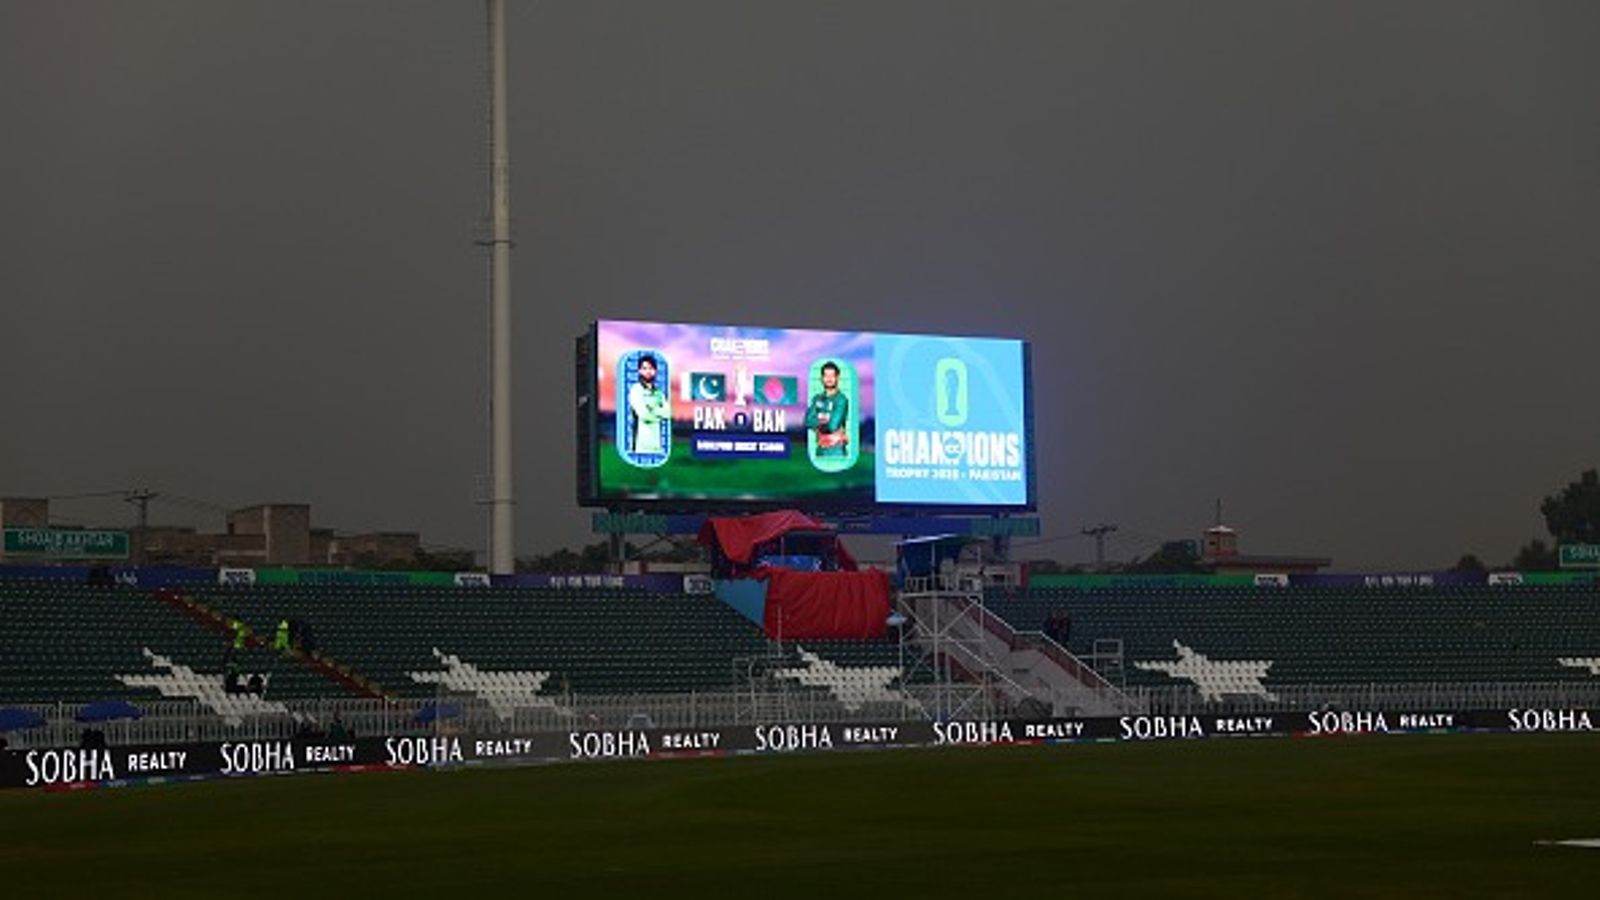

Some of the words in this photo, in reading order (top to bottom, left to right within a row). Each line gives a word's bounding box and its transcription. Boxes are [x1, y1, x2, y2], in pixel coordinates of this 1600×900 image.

[693, 406, 726, 430] PAK
[753, 409, 786, 433] BAN
[886, 467, 928, 479] TROPHY
[969, 469, 1021, 481] PAKISTAN
[1119, 715, 1204, 741] SOBHA
[1216, 717, 1273, 732] REALTY
[1308, 710, 1388, 735] SOBHA
[1400, 713, 1454, 728] REALTY
[1508, 708, 1593, 731] SOBHA
[569, 731, 650, 759] SOBHA
[663, 732, 720, 749] REALTY
[755, 724, 833, 752] SOBHA
[844, 726, 898, 743] REALTY
[933, 720, 1014, 745] SOBHA
[1025, 722, 1084, 738] REALTY
[220, 741, 295, 774] SOBHA
[306, 745, 355, 763] REALTY
[386, 737, 464, 767] SOBHA
[475, 739, 533, 757] REALTY
[25, 749, 114, 786] SOBHA
[128, 751, 187, 772] REALTY
